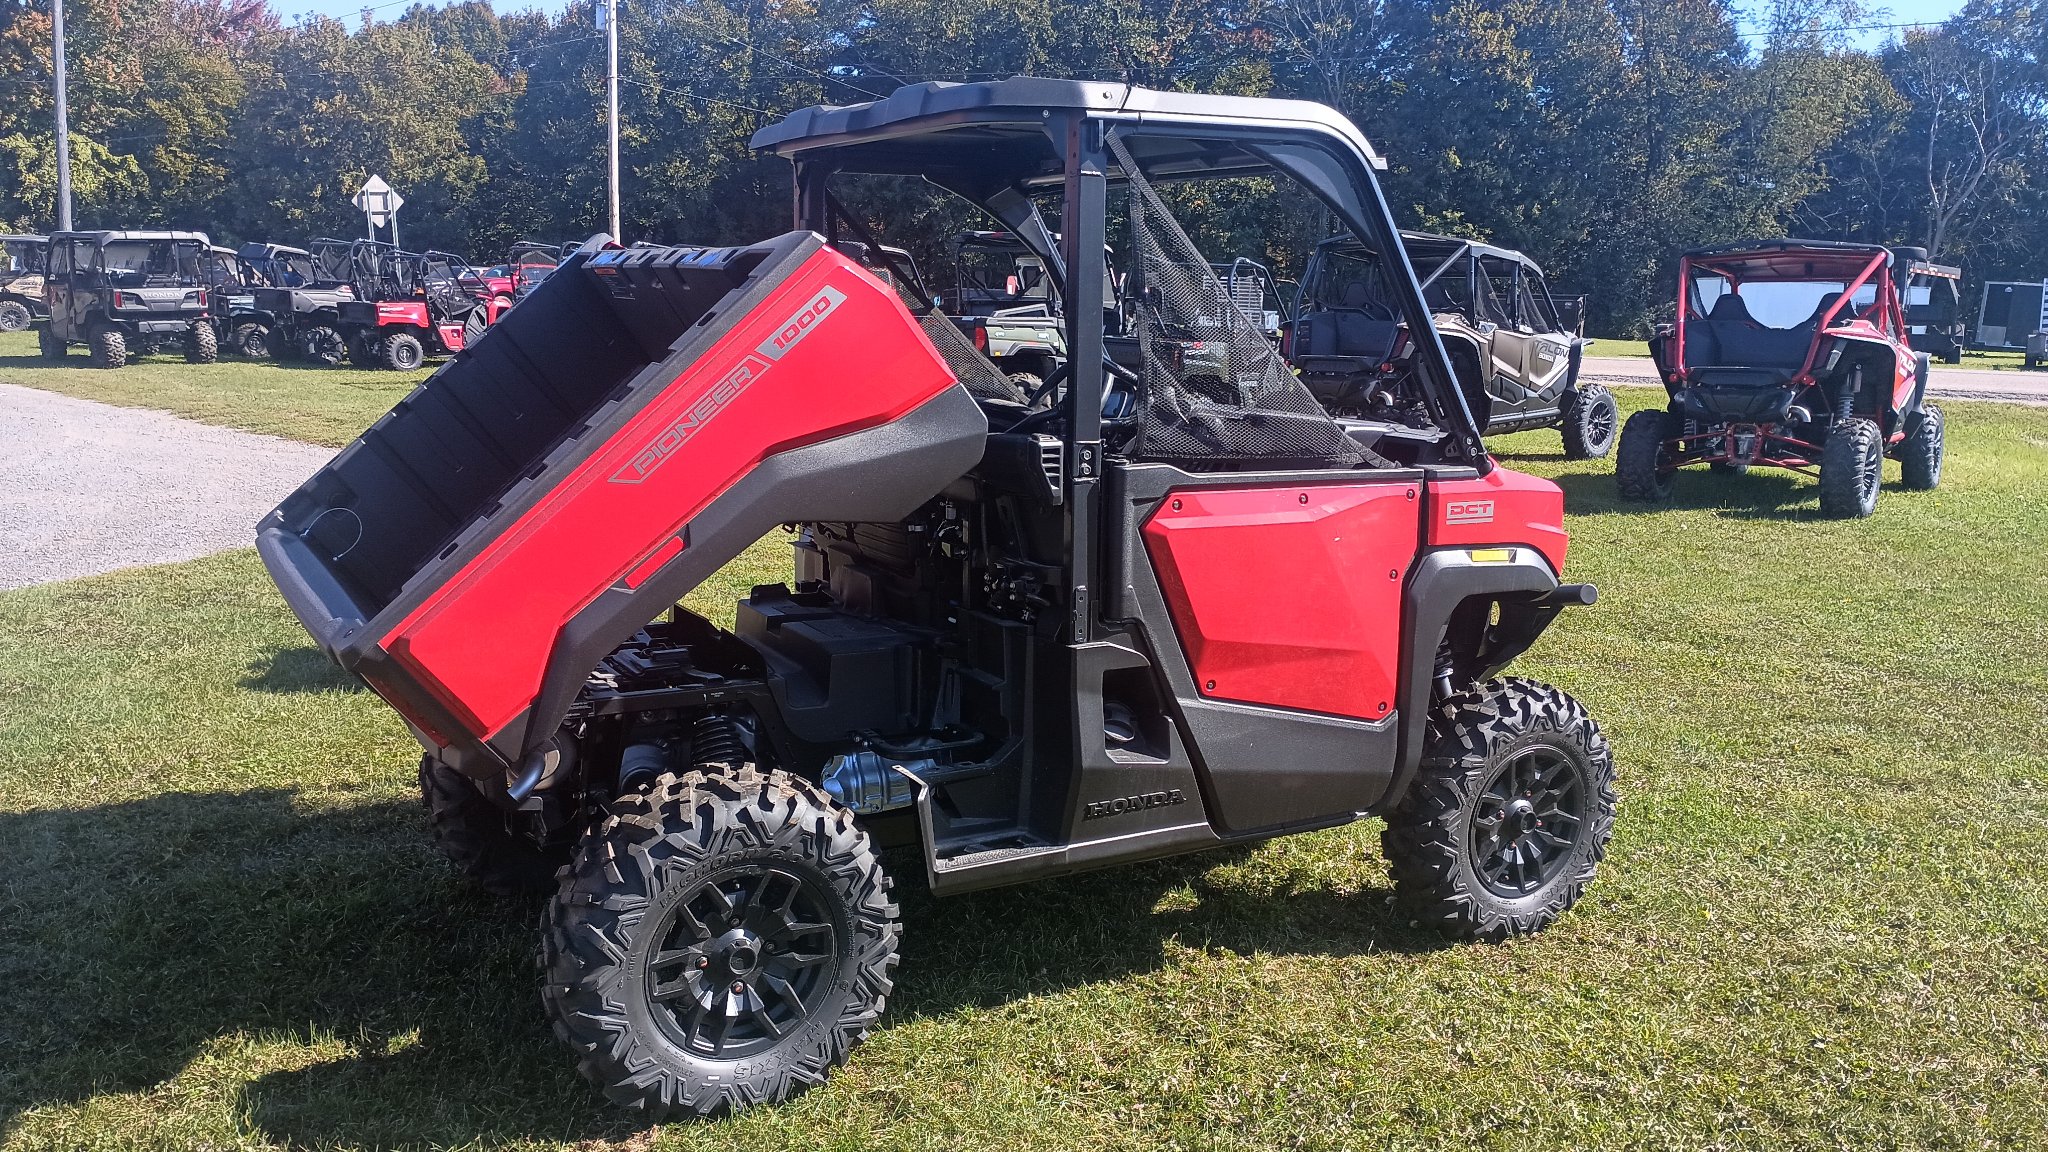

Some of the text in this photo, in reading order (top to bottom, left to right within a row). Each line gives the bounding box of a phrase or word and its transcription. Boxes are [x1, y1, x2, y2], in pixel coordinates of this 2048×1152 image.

[143, 291, 182, 299] HONDA
[1535, 340, 1569, 358] TALON
[632, 295, 832, 476] PIONEER 1000
[1450, 503, 1491, 515] DCT
[1083, 788, 1187, 820] HONDA
